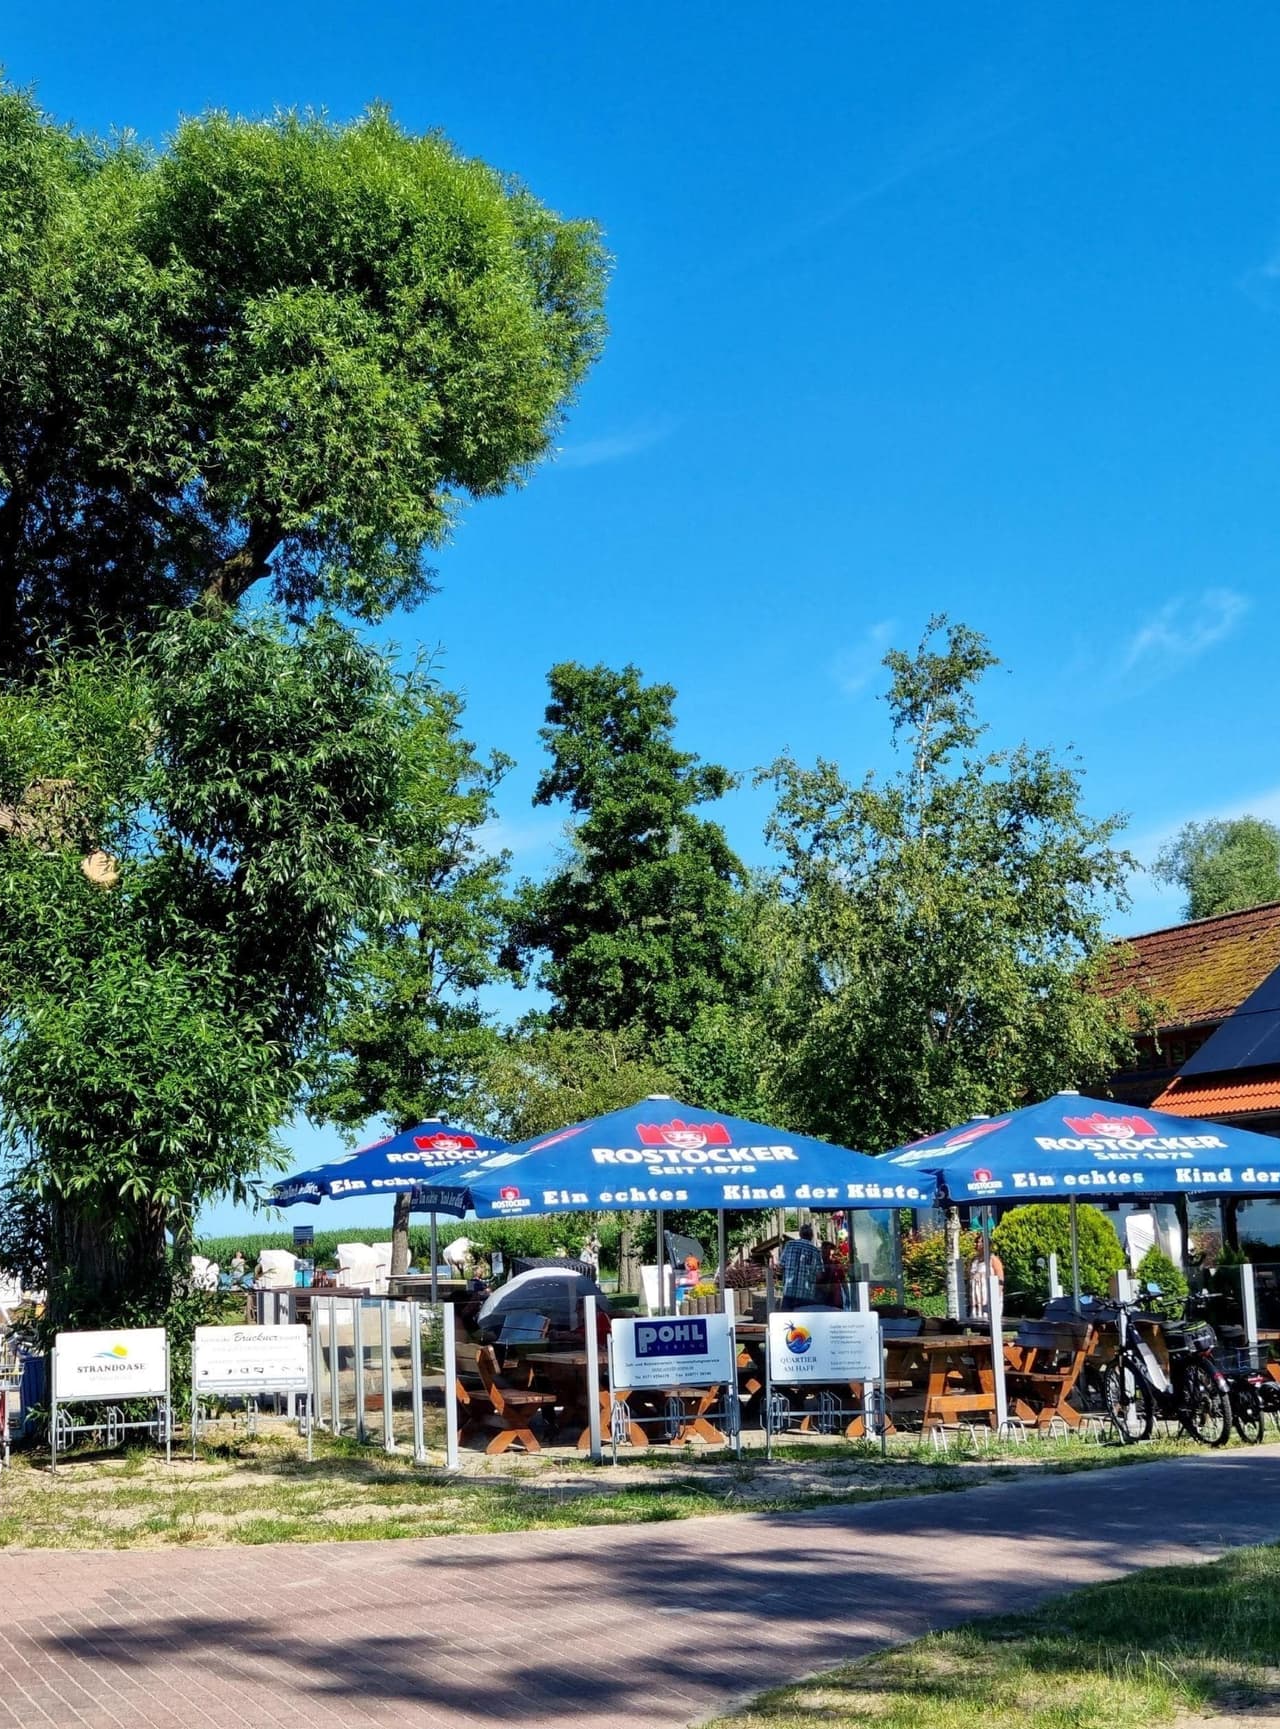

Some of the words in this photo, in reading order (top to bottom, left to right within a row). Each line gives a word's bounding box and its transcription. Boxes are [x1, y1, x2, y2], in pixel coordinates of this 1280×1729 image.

[1035, 1135, 1228, 1151] ROSTOCKER
[592, 1146, 799, 1164] ROSTOCKER
[1094, 1151, 1139, 1160] SEIT
[648, 1165, 697, 1175] SEIT
[699, 1164, 757, 1174] 1878
[1012, 1173, 1055, 1188] Ein
[1064, 1170, 1145, 1185] echtes
[1175, 1168, 1233, 1184] Kind
[330, 1179, 367, 1194] Ein
[543, 1190, 589, 1205] Ein
[599, 1187, 689, 1203] echtes
[723, 1184, 785, 1200] Kind
[795, 1184, 839, 1199] der
[847, 1183, 928, 1201] Küste.
[638, 1324, 704, 1353] POHL
[780, 1356, 817, 1364] QUARTIER
[77, 1363, 145, 1373] STRANDOASE
